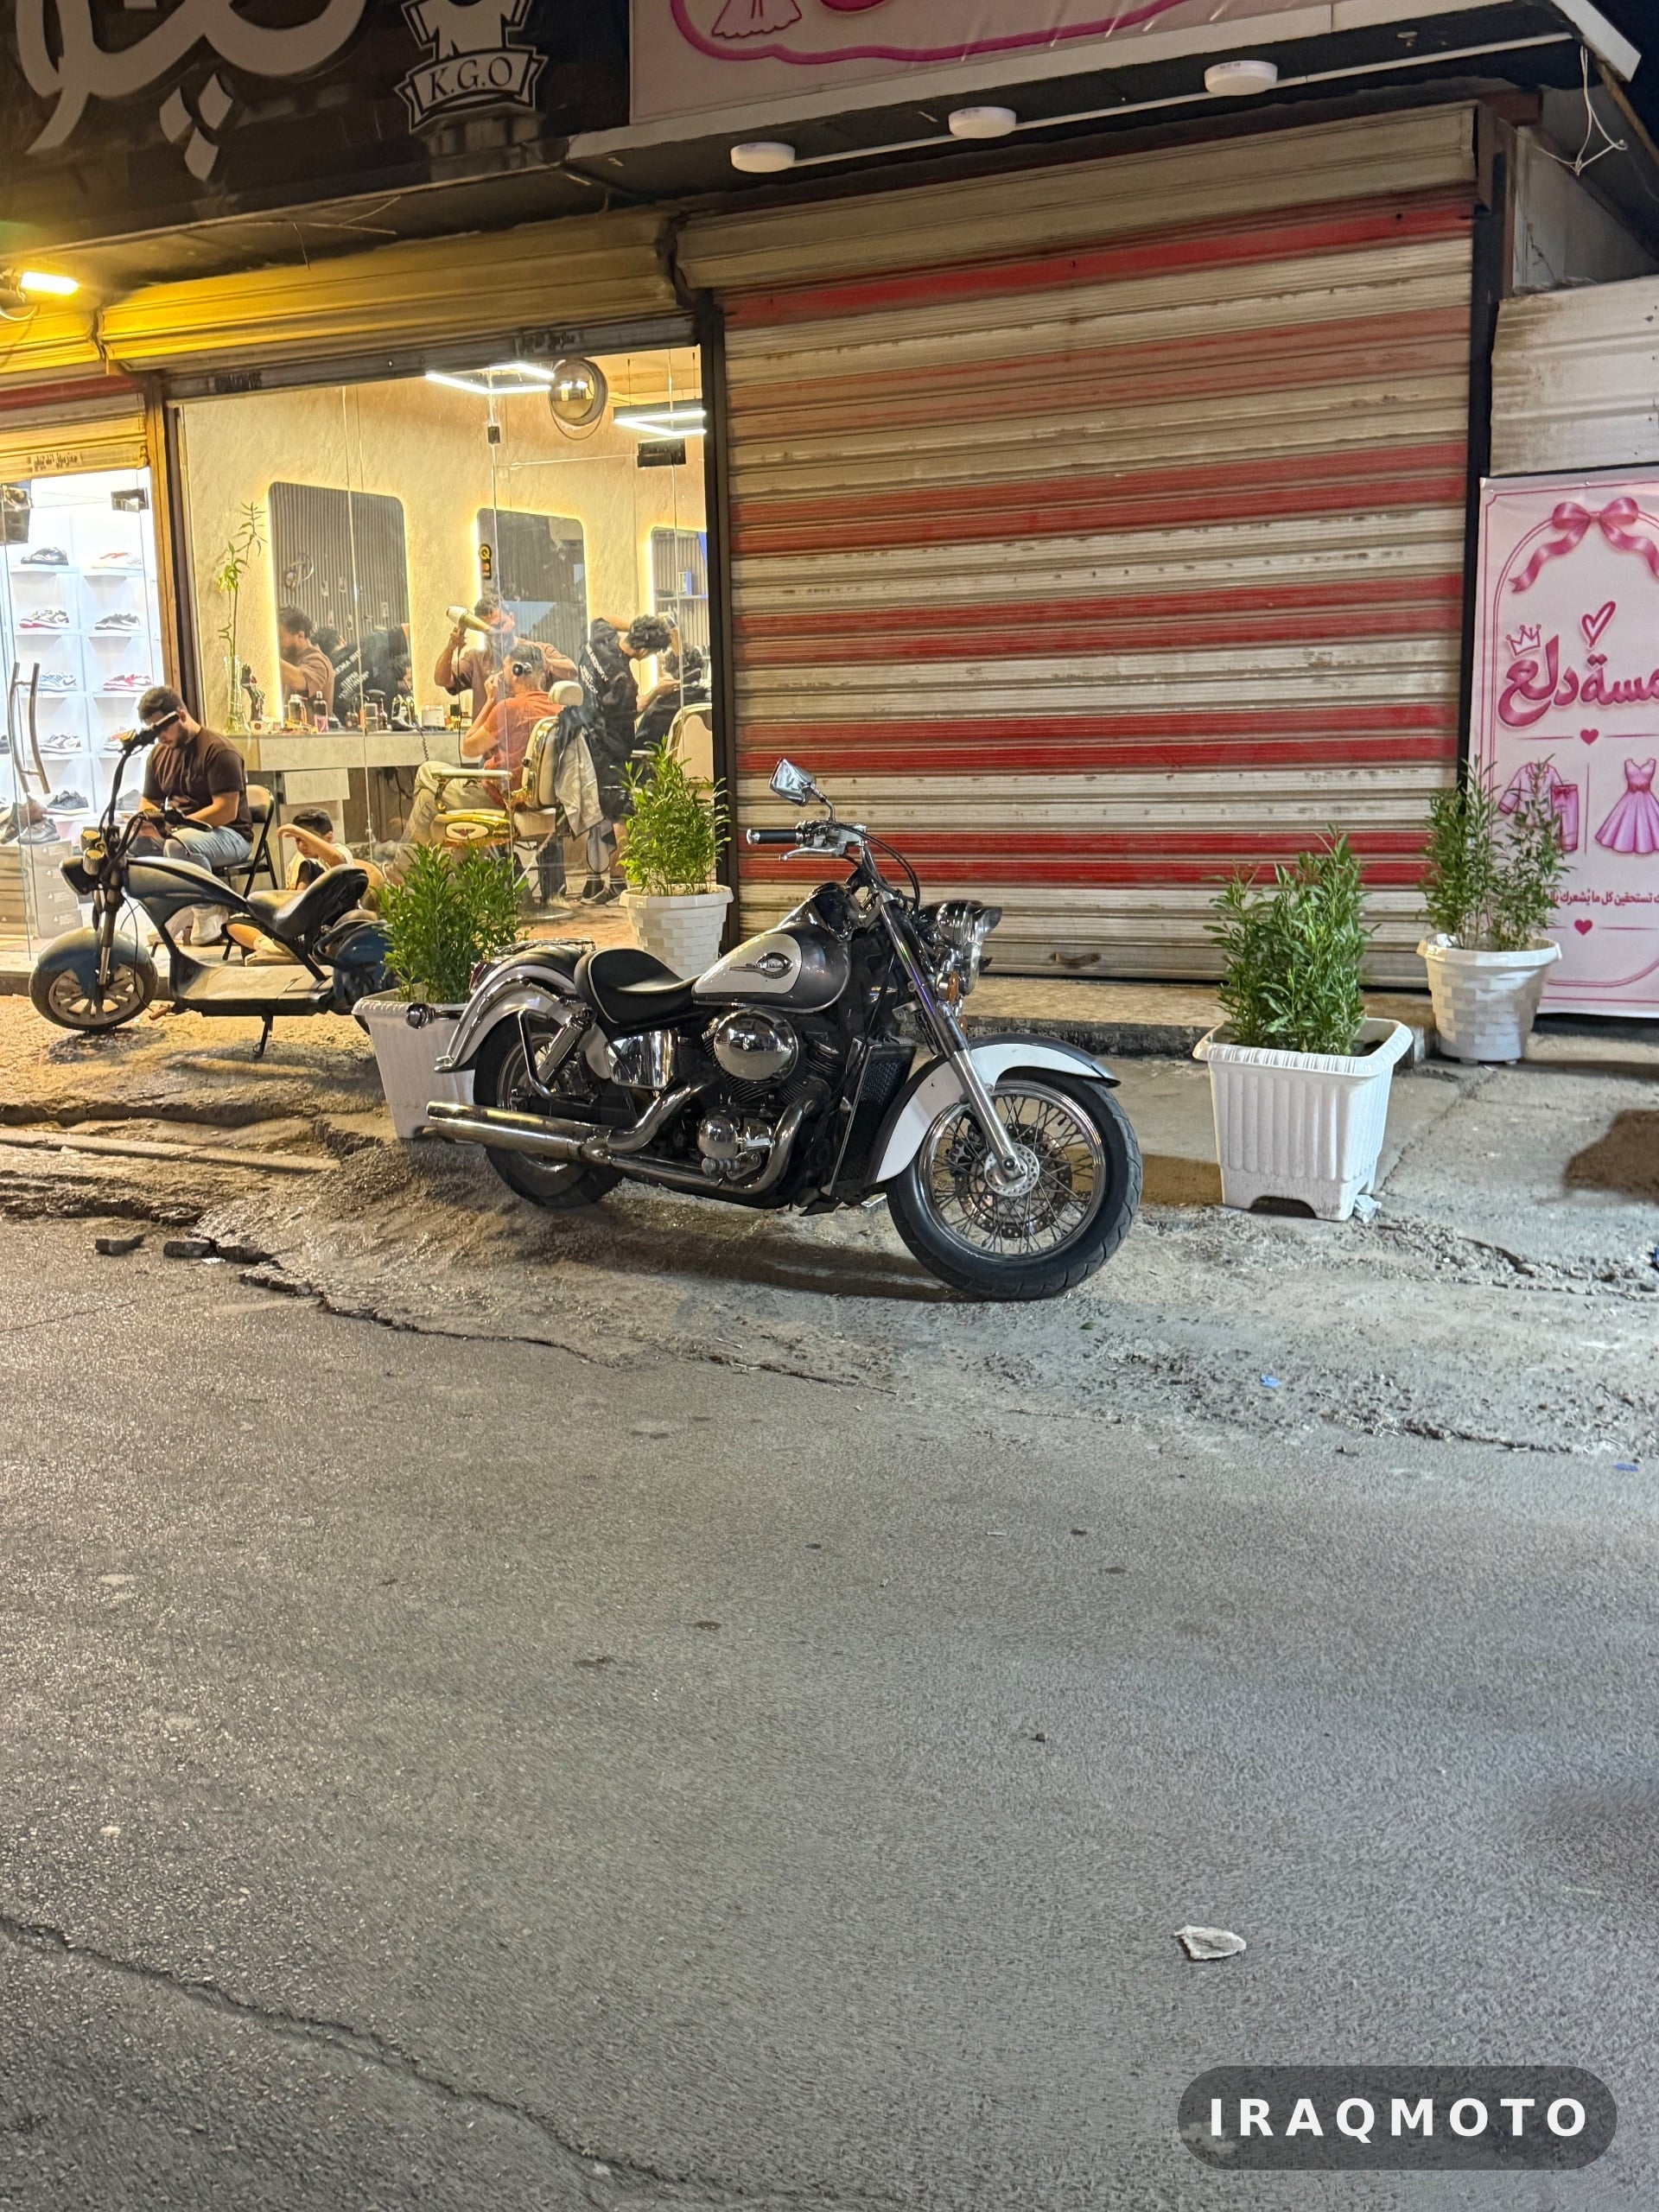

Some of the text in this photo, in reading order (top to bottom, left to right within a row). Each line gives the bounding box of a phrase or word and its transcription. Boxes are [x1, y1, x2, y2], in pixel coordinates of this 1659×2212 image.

[430, 57, 512, 101] K.G.O
[1498, 635, 1580, 727] دلع
[1592, 890, 1600, 902] ما
[1601, 891, 1613, 906] كل
[1614, 892, 1653, 906] تستحقين
